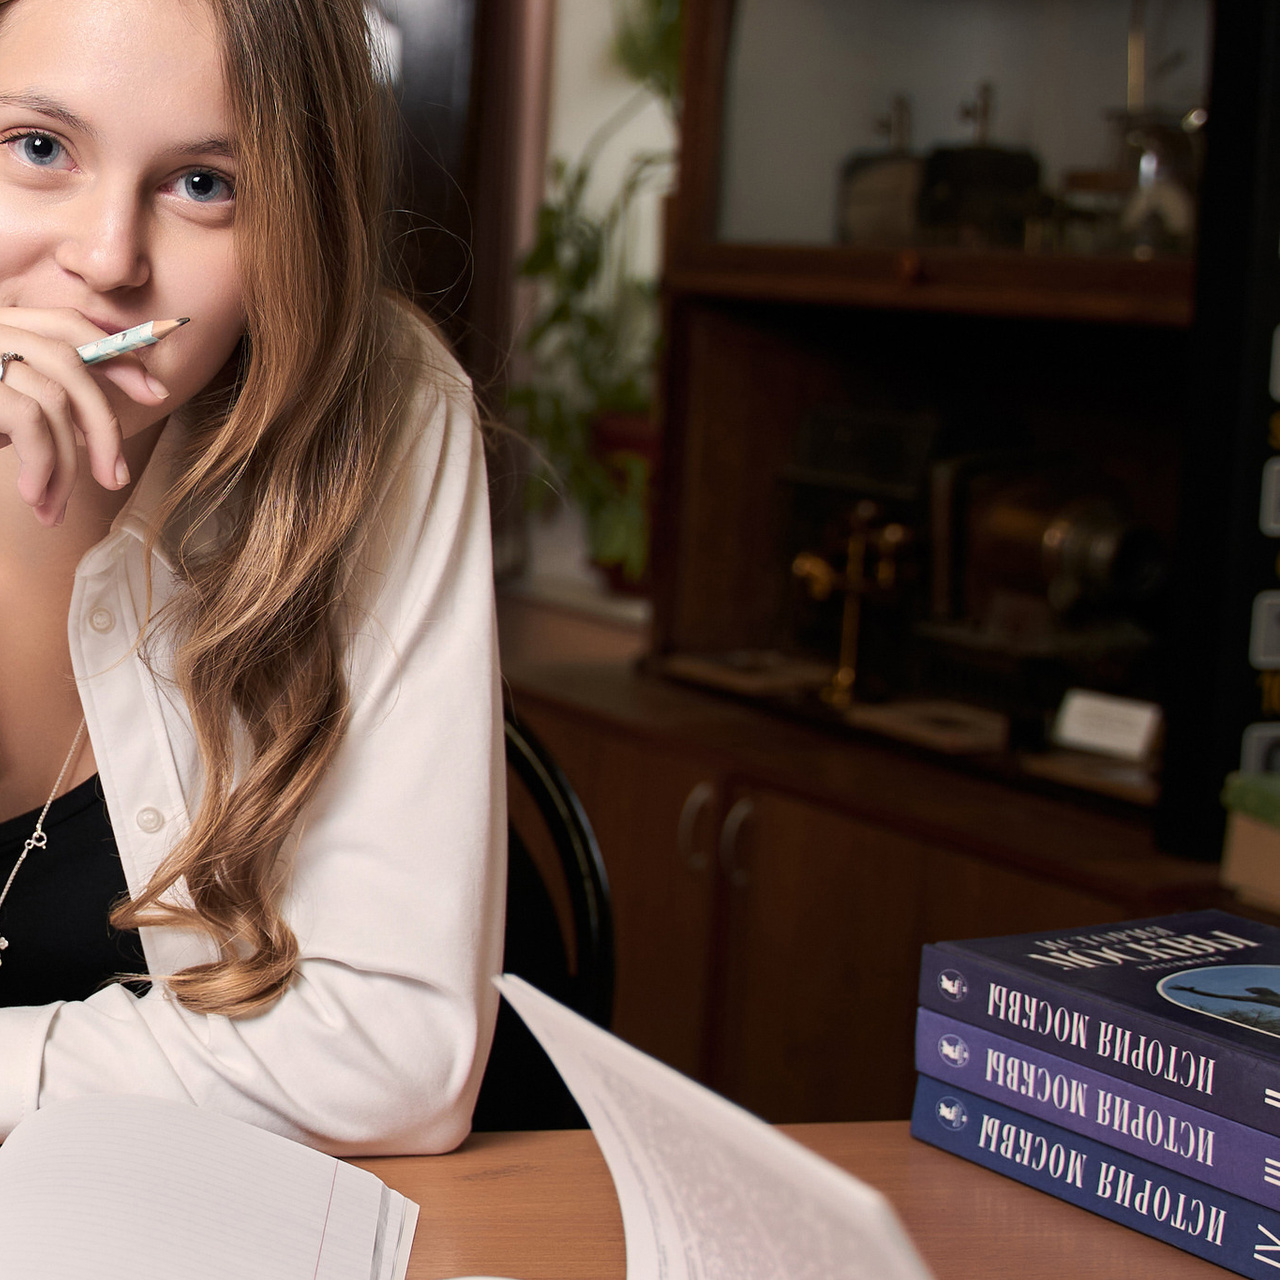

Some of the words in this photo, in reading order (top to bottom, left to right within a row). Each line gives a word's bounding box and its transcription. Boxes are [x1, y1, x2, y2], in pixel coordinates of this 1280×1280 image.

[1027, 930, 1261, 970] МОСКВЫ
[1034, 926, 1176, 950] ИСТОРИЯ
[987, 982, 1090, 1050] МОСКВЫ
[985, 1048, 1088, 1118] МОСКВЫ
[1097, 1021, 1216, 1096] ИСТОРИЯ
[978, 1114, 1087, 1189] МОСКВЫ
[1096, 1089, 1215, 1167] ИСТОРИЯ
[1096, 1161, 1227, 1246] ИСТОРИЯ
